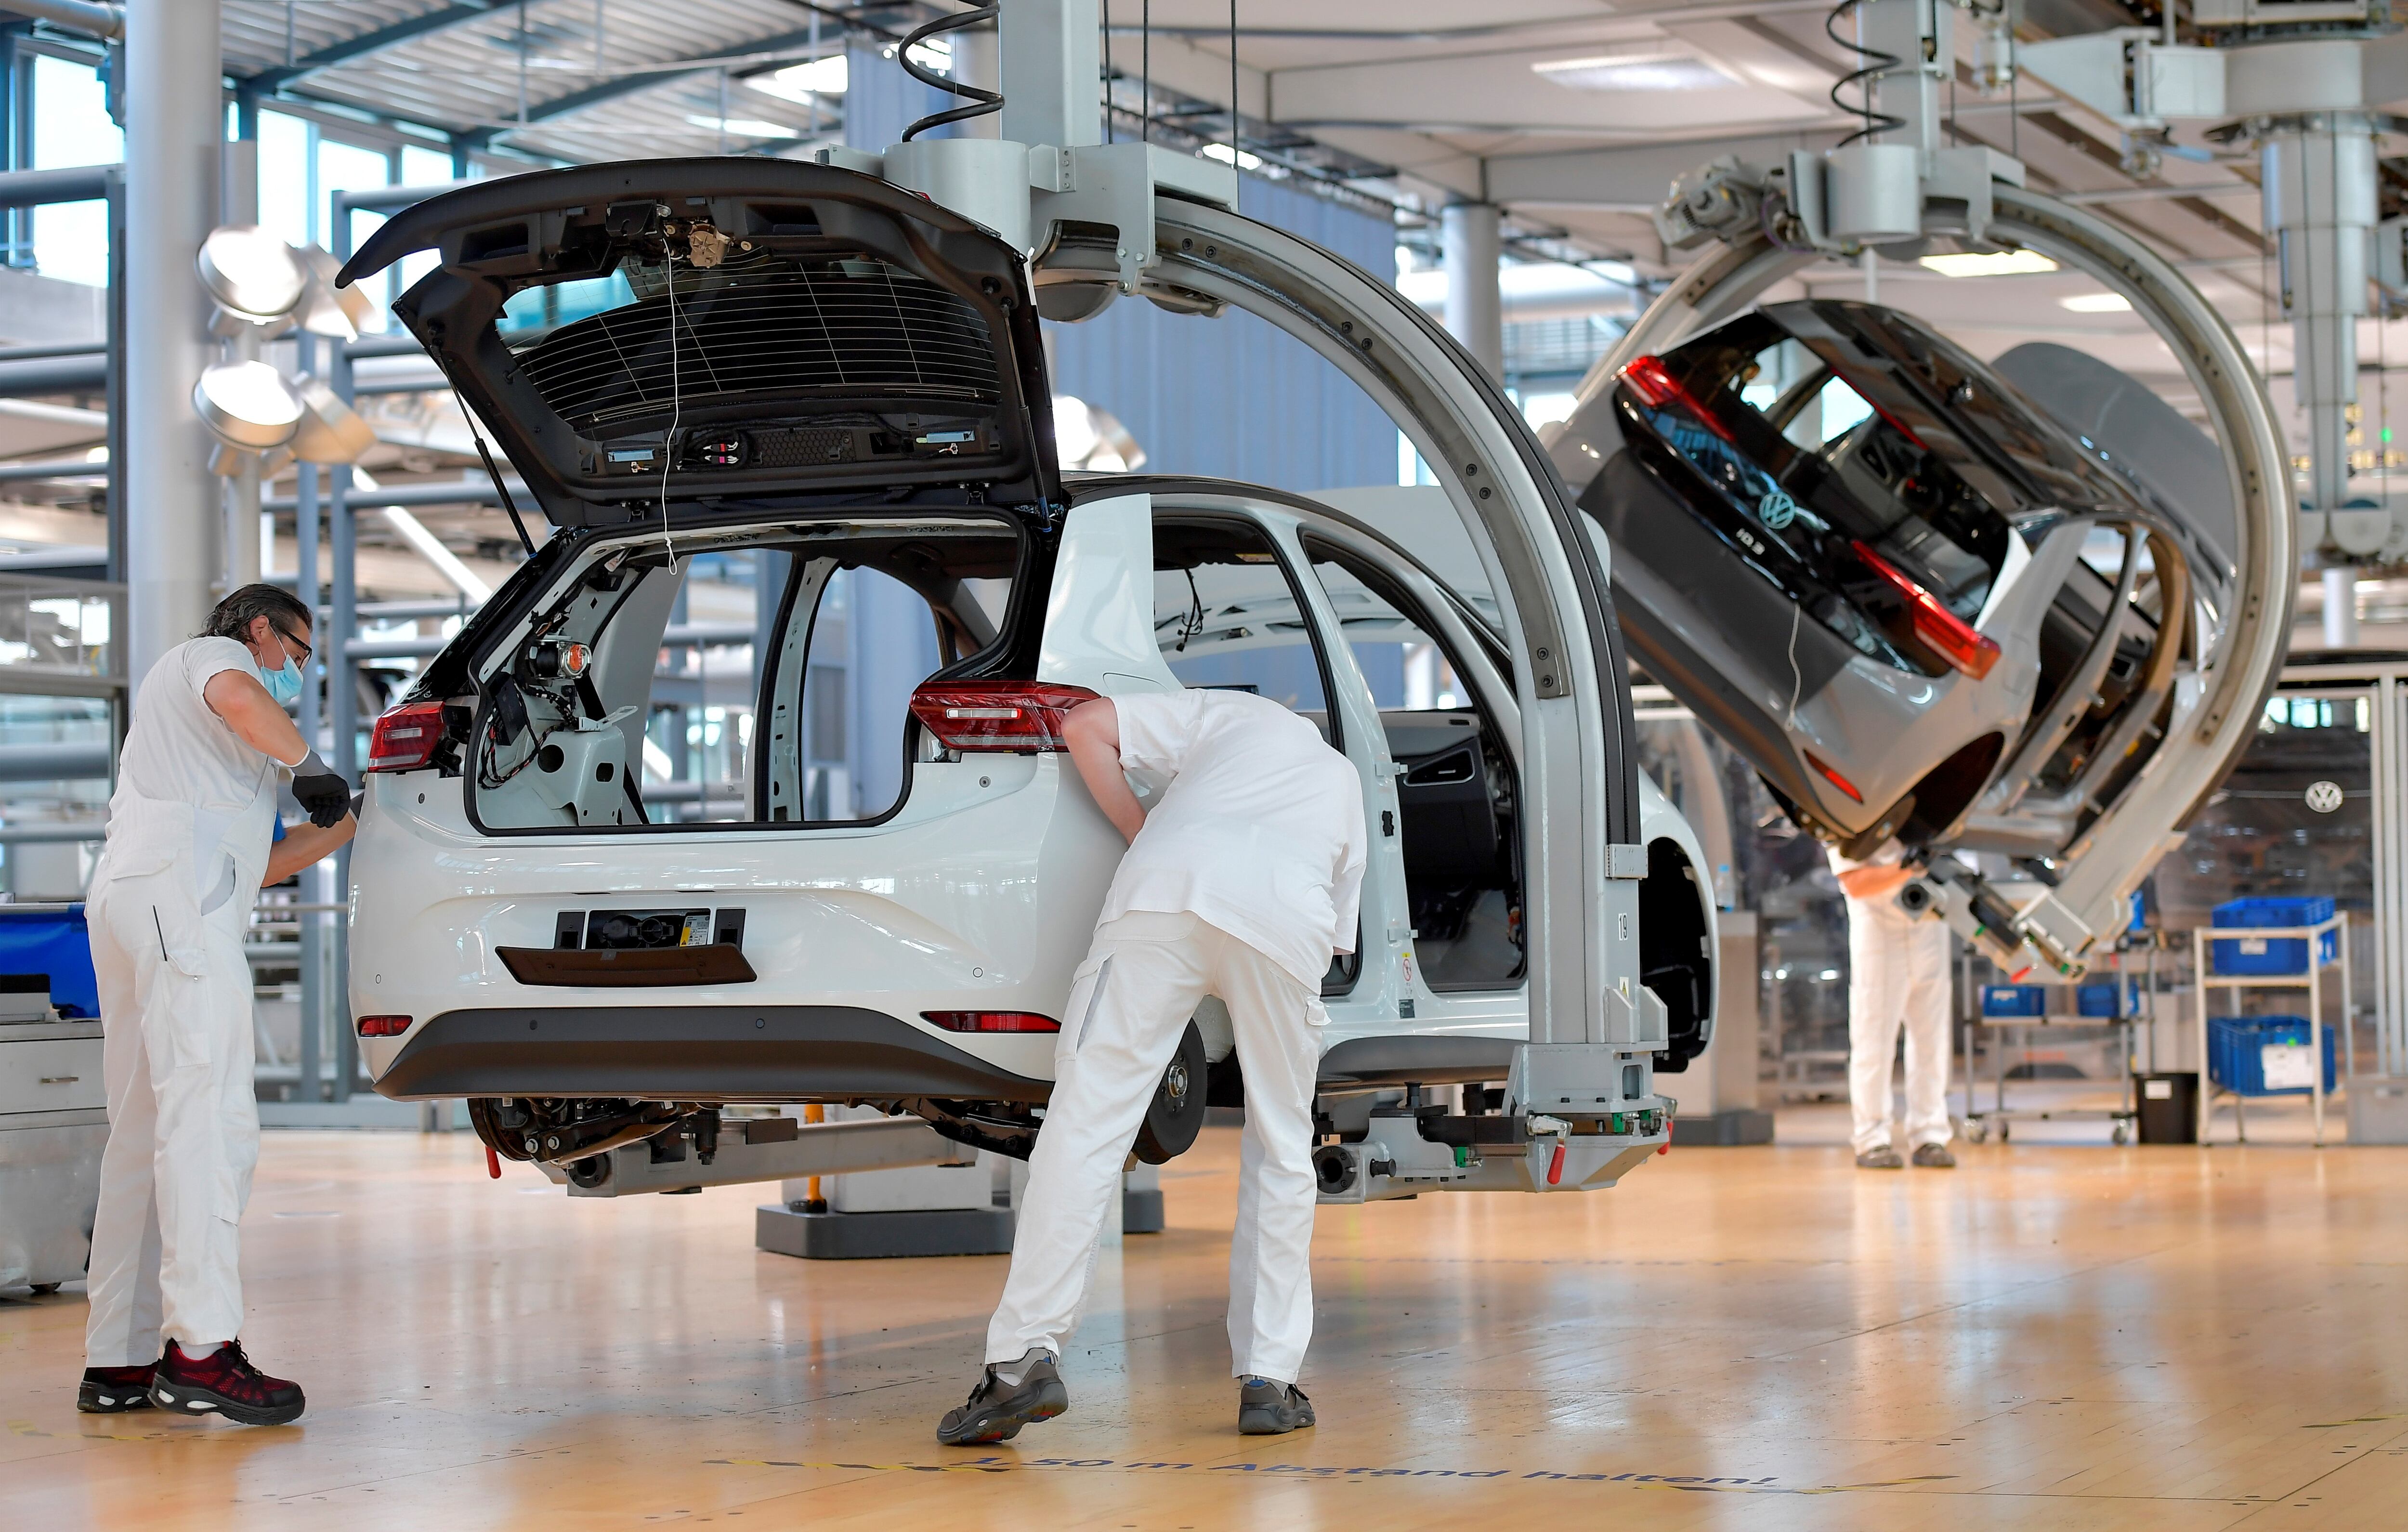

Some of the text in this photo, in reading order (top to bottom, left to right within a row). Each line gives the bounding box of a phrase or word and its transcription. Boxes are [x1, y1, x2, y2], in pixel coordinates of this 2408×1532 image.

[1759, 492, 1795, 529] VW
[1619, 914, 1627, 939] 19
[1207, 1464, 1512, 1477] Abstand
[1520, 1471, 1780, 1484] halten!
